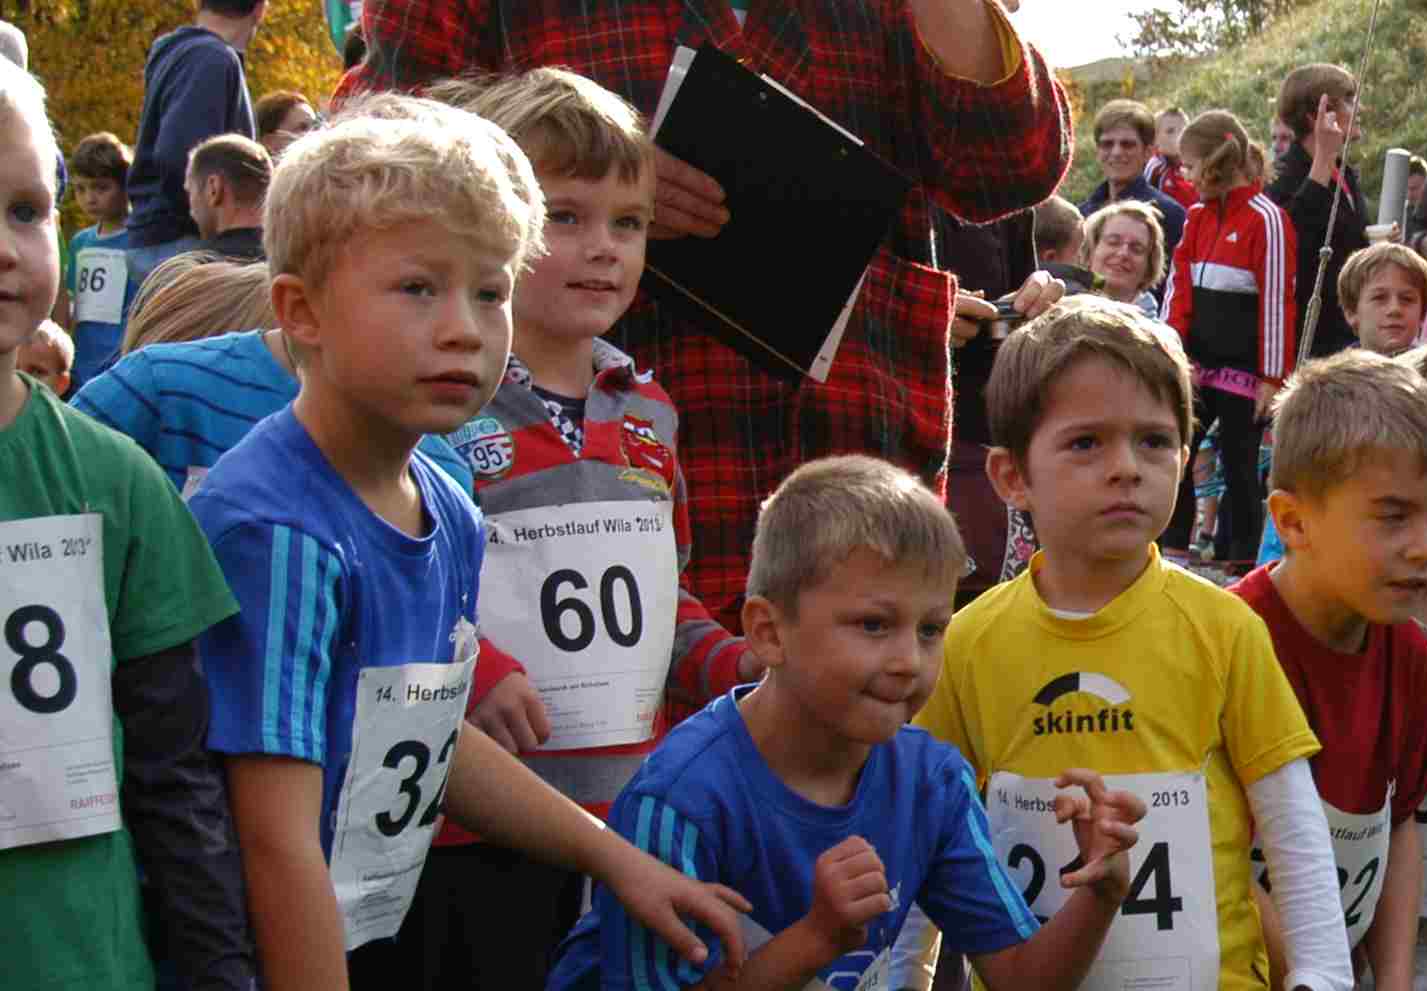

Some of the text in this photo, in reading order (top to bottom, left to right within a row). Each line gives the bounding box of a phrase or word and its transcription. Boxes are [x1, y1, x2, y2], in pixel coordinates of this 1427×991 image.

[473, 442, 503, 470] 95
[514, 518, 600, 543] Herbstlauf
[602, 517, 632, 537] Wila
[7, 541, 53, 563] Wila
[539, 564, 643, 653] 60
[375, 685, 397, 704] 14.
[1032, 708, 1135, 737] skinfit
[1151, 789, 1189, 808] 2013
[1007, 841, 1183, 931] 24
